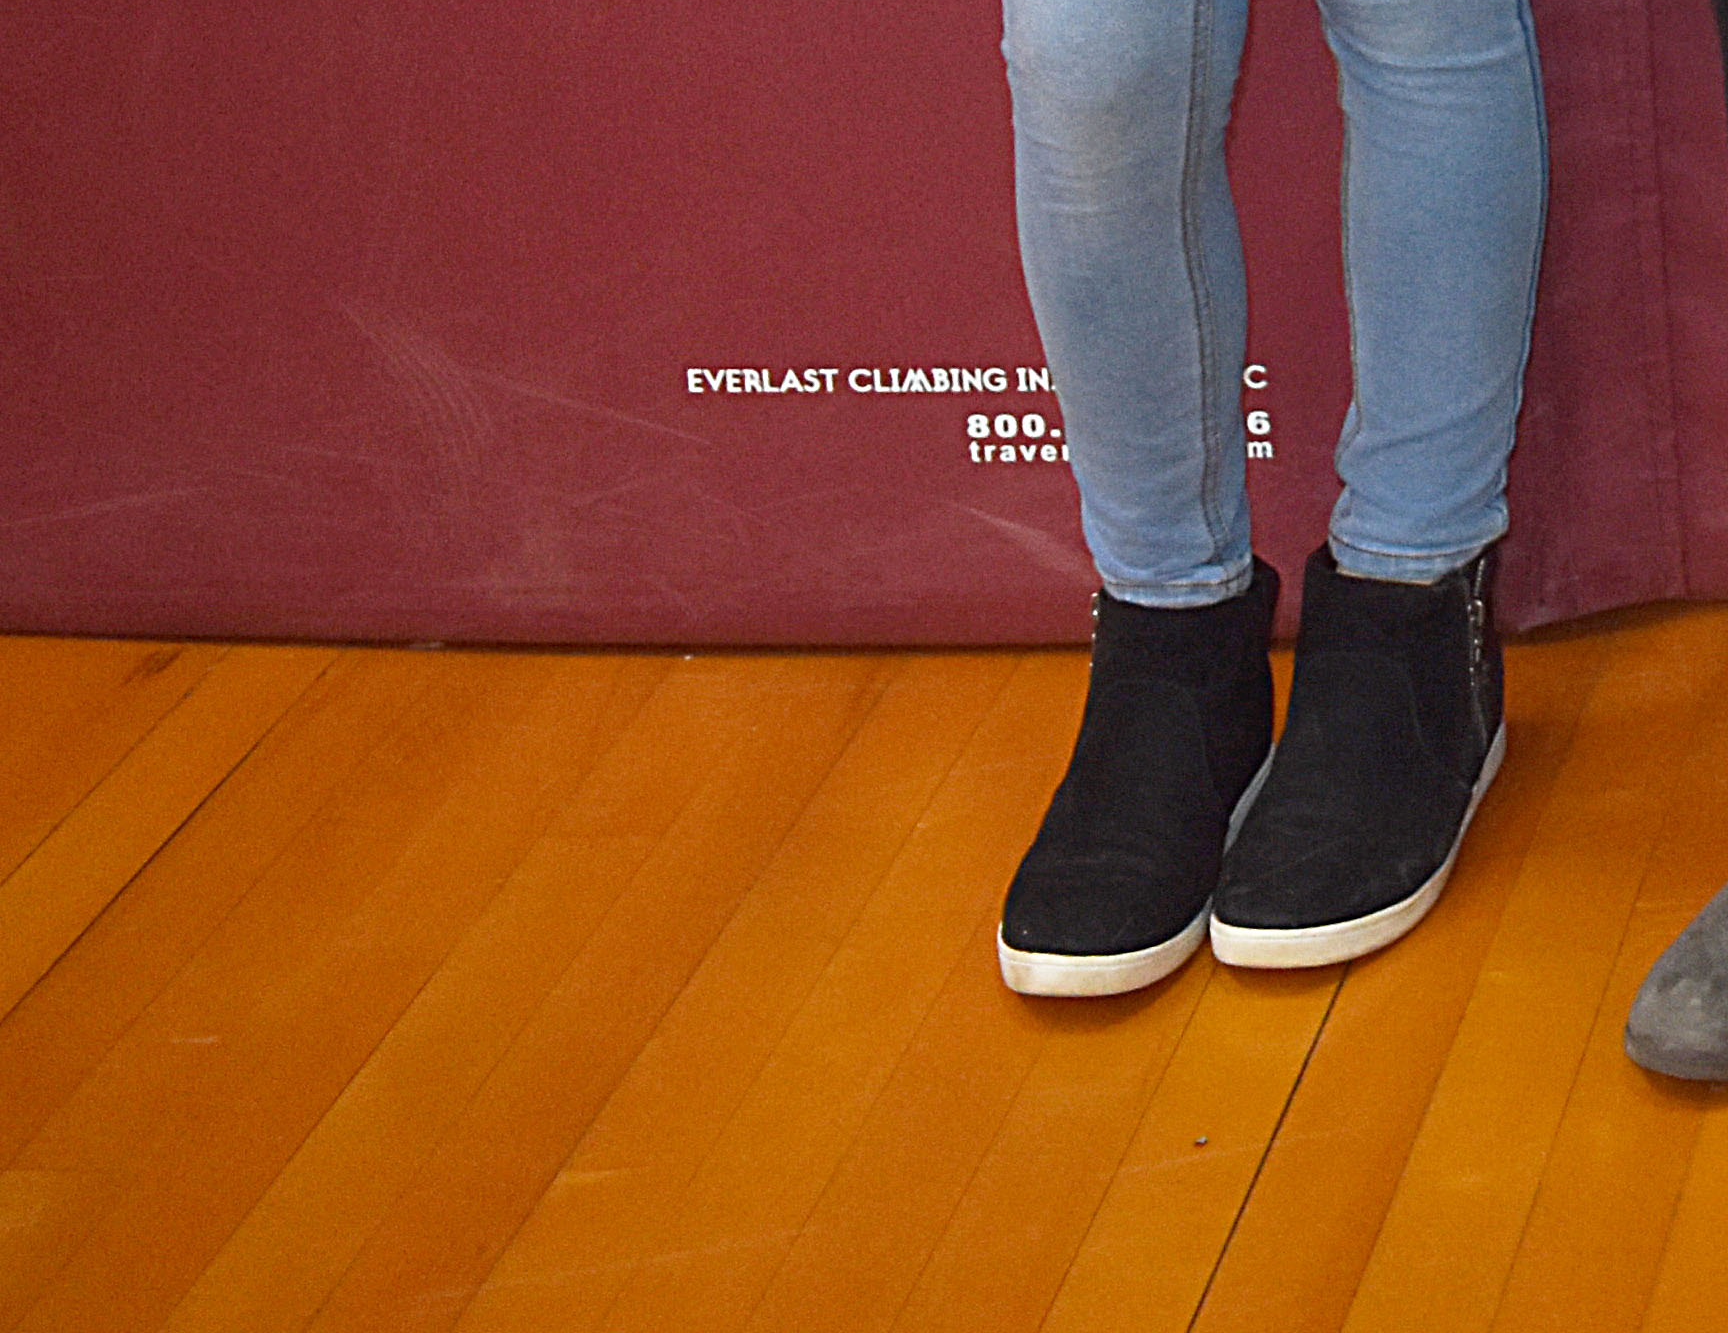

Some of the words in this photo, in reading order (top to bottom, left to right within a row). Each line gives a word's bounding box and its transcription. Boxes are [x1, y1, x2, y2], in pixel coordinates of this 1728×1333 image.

[686, 368, 839, 393] EVERLAST
[847, 367, 1008, 392] CLIMBING
[967, 414, 1062, 439] 800.
